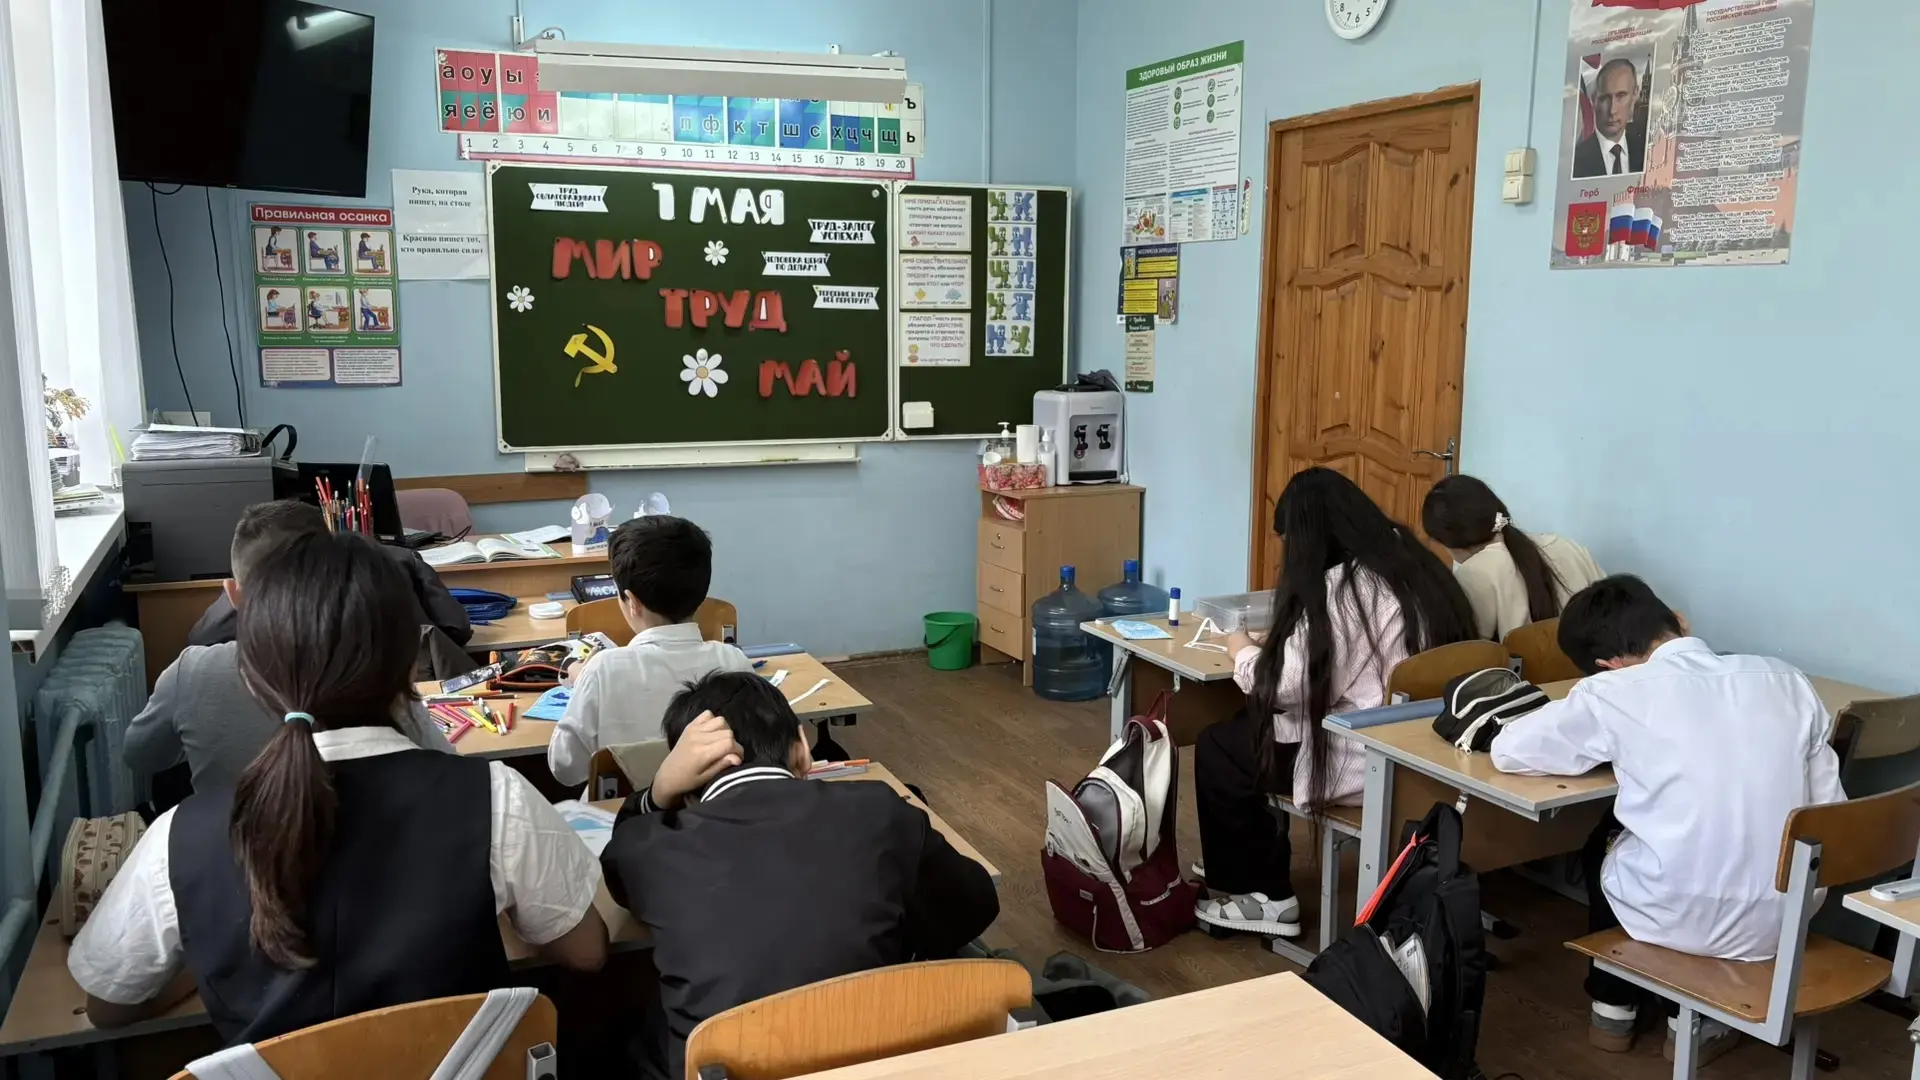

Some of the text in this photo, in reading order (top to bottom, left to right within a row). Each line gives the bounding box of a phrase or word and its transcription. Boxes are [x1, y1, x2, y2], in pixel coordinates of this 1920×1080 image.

[1340, 3, 1345, 12] 8
[1366, 8, 1371, 16] 5
[1347, 12, 1352, 21] 7
[1355, 14, 1360, 23] 6
[1139, 63, 1175, 81] ЗДОРОВЫЙ
[1176, 58, 1199, 72] ОБРАЗ
[1200, 51, 1227, 66] ЖИЗНИ
[443, 66, 522, 84] а о у ы
[904, 99, 917, 109] ъ
[444, 102, 916, 144] я е ё ю и п ф к т ш с х ц ч щ ь
[467, 139, 906, 169] 1 2 3 4 5 6 7 8 9 10 11 12 13 14 15 16 17 18 19 20
[412, 186, 468, 197] Рука, которая
[1580, 188, 1600, 199] Герб
[652, 183, 785, 225] 1 МАЯ
[256, 207, 388, 223] Правильная осанка
[812, 222, 872, 232] ТРУД-ЗАЛОГ
[403, 235, 437, 243] Красиво
[821, 232, 864, 241] УСПЕХА!
[552, 237, 663, 280] МИР
[765, 256, 828, 265] ЧЕЛОВЕКА ЦЕНЯТ
[787, 264, 817, 272] ДЕЛАМ!
[658, 288, 788, 333] ТРУД
[758, 349, 856, 397] МАЙ
